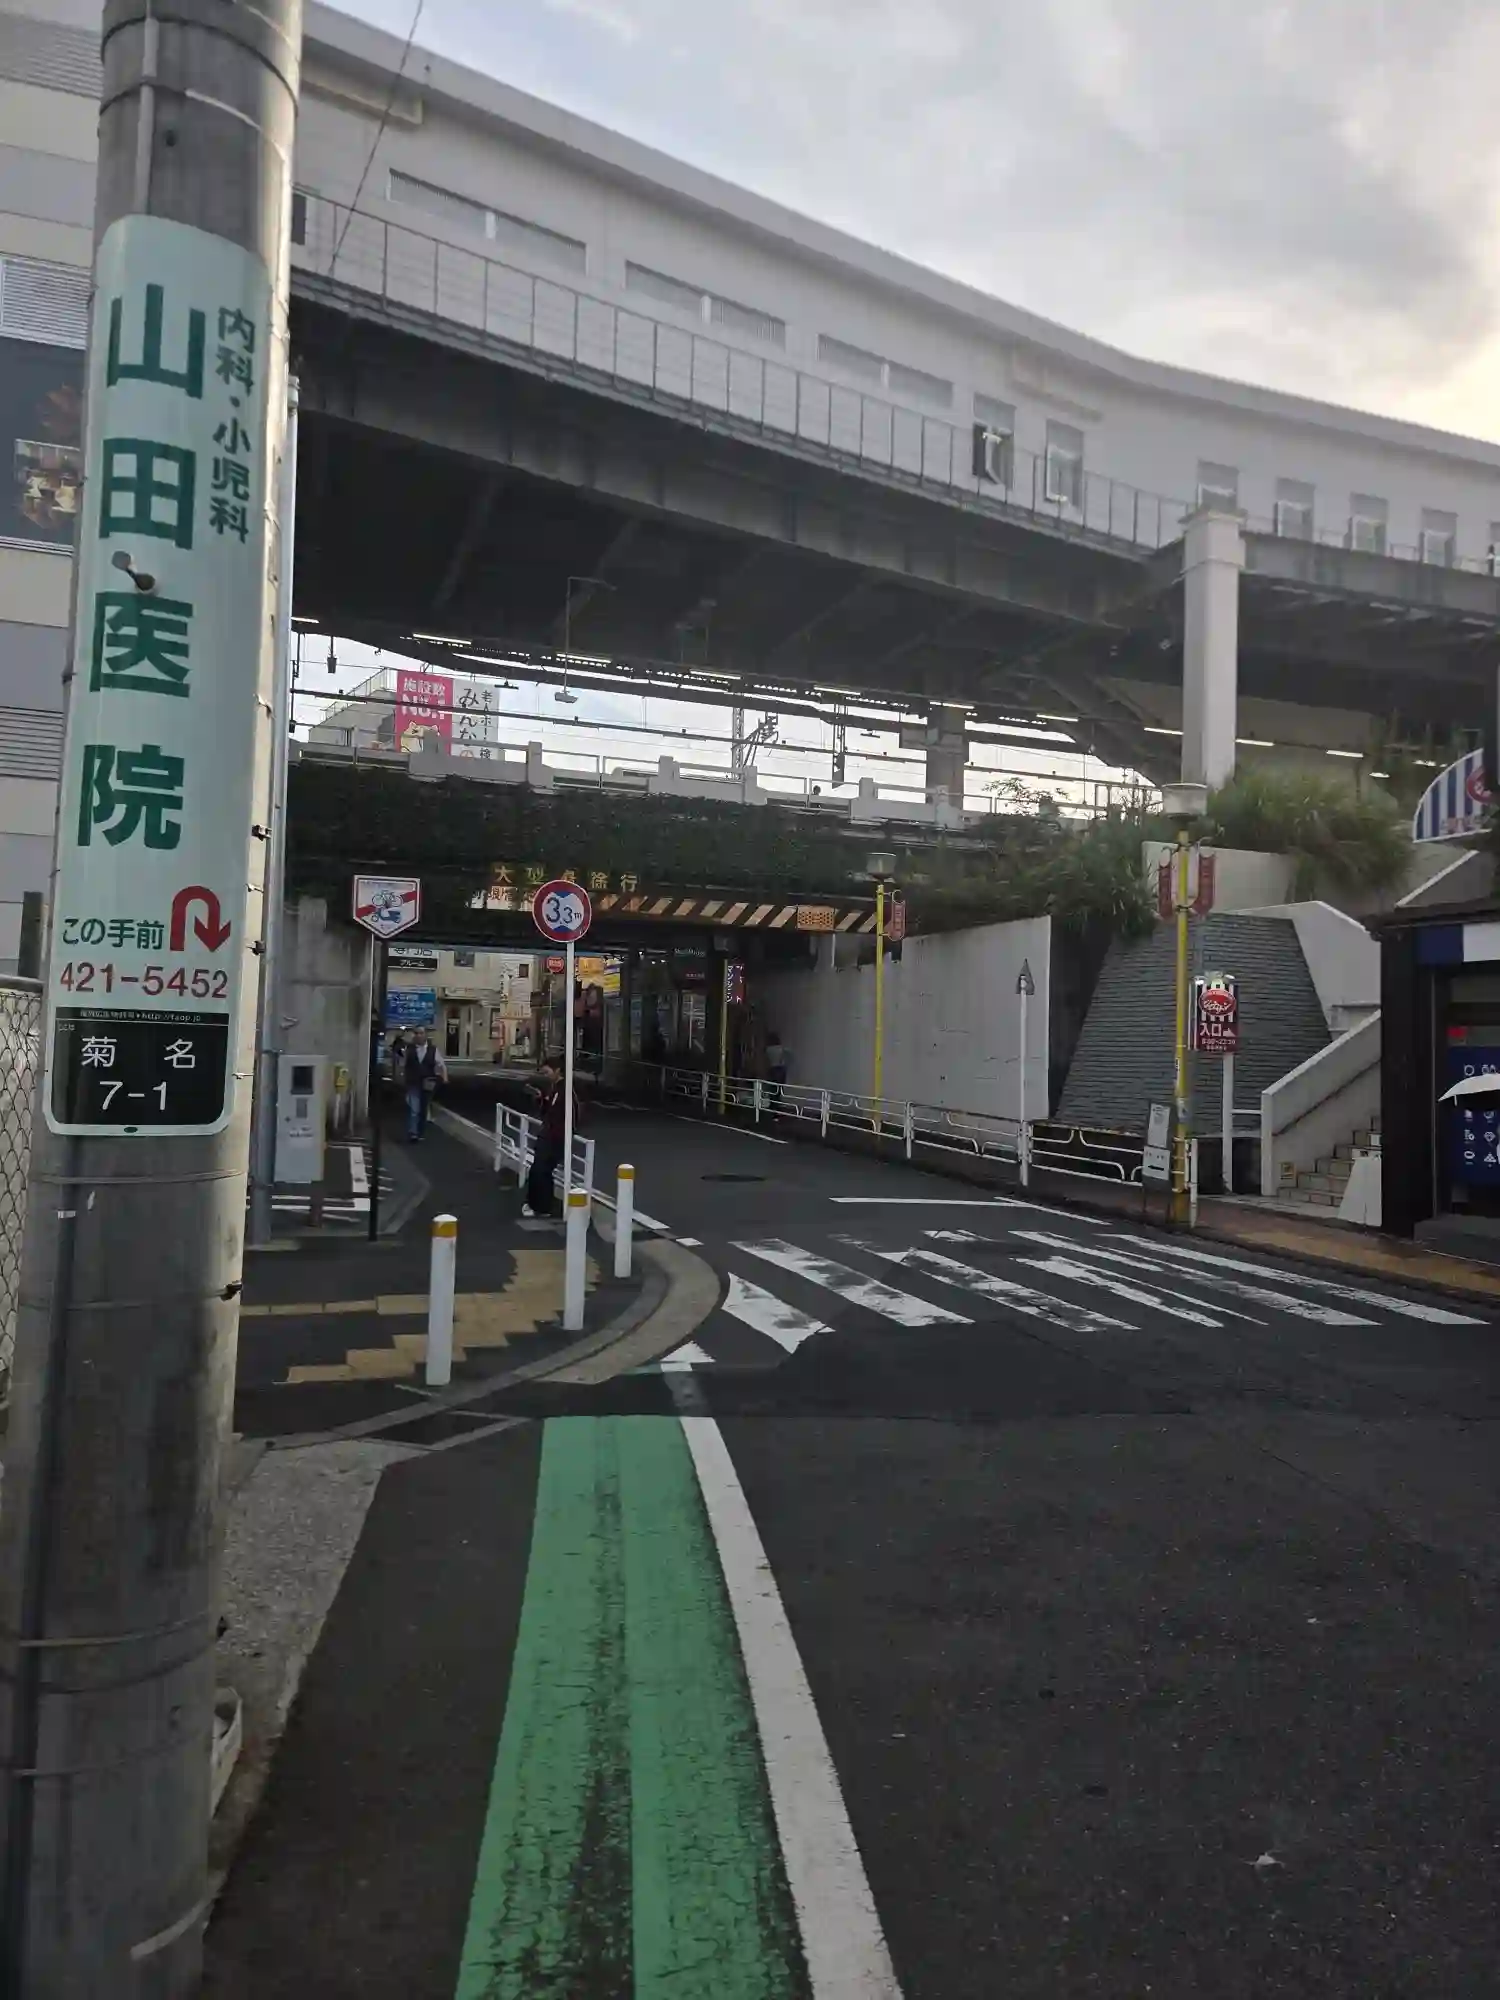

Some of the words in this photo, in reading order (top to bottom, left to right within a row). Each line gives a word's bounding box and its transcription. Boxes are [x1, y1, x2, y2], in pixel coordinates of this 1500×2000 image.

[209, 306, 256, 545] 内科・小児科
[77, 283, 206, 850] 山田医院
[458, 688, 480, 745] みんな
[62, 918, 165, 950] この手前
[60, 962, 228, 999] 421-5452
[1199, 1022, 1222, 1037] 入口
[99, 1080, 168, 1111] 7-1
